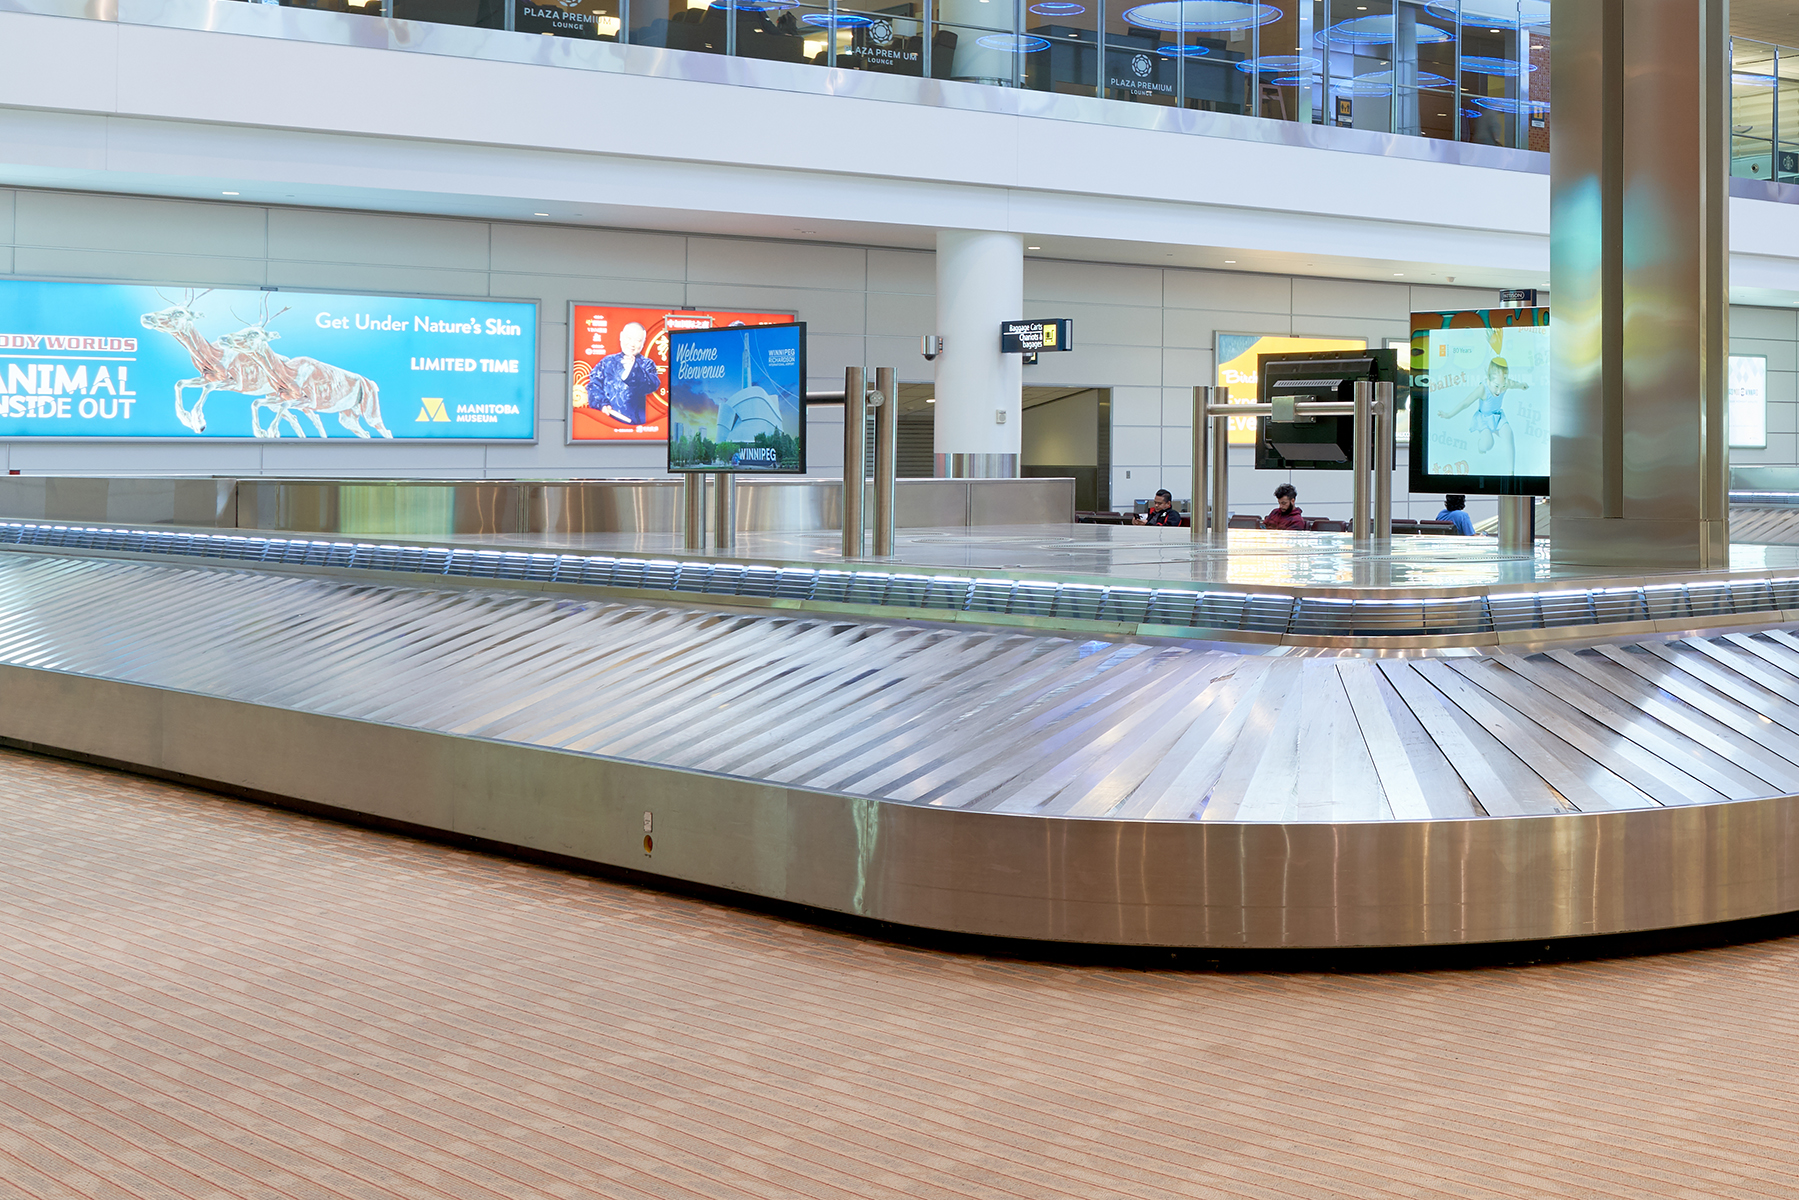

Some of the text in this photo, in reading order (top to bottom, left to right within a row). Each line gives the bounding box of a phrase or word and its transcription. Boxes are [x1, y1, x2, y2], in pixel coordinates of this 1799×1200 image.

[524, 7, 611, 25] PLAZA PREMIUM
[553, 21, 583, 30] LOUNGE
[868, 57, 893, 65] LOUNGE
[876, 48, 917, 61] PREMUM
[1110, 78, 1172, 92] PLAZA PREMIUM
[315, 312, 521, 336] Get Under Nature's Skin
[1009, 323, 1043, 333] Baggage Carts
[46, 336, 136, 351] WORLDS
[1022, 341, 1043, 349] bagages
[676, 342, 718, 362] Welcome
[768, 348, 795, 356] WINNIPEG
[411, 357, 519, 373] LIMITED TIME
[678, 360, 726, 380] Bienvenue
[1429, 371, 1467, 392] ballet
[78, 397, 137, 419] OUT
[456, 404, 520, 414] MANITOBA
[1517, 402, 1541, 425] hip
[456, 414, 498, 423] MUSEUM
[739, 448, 776, 461] WINNIPEG
